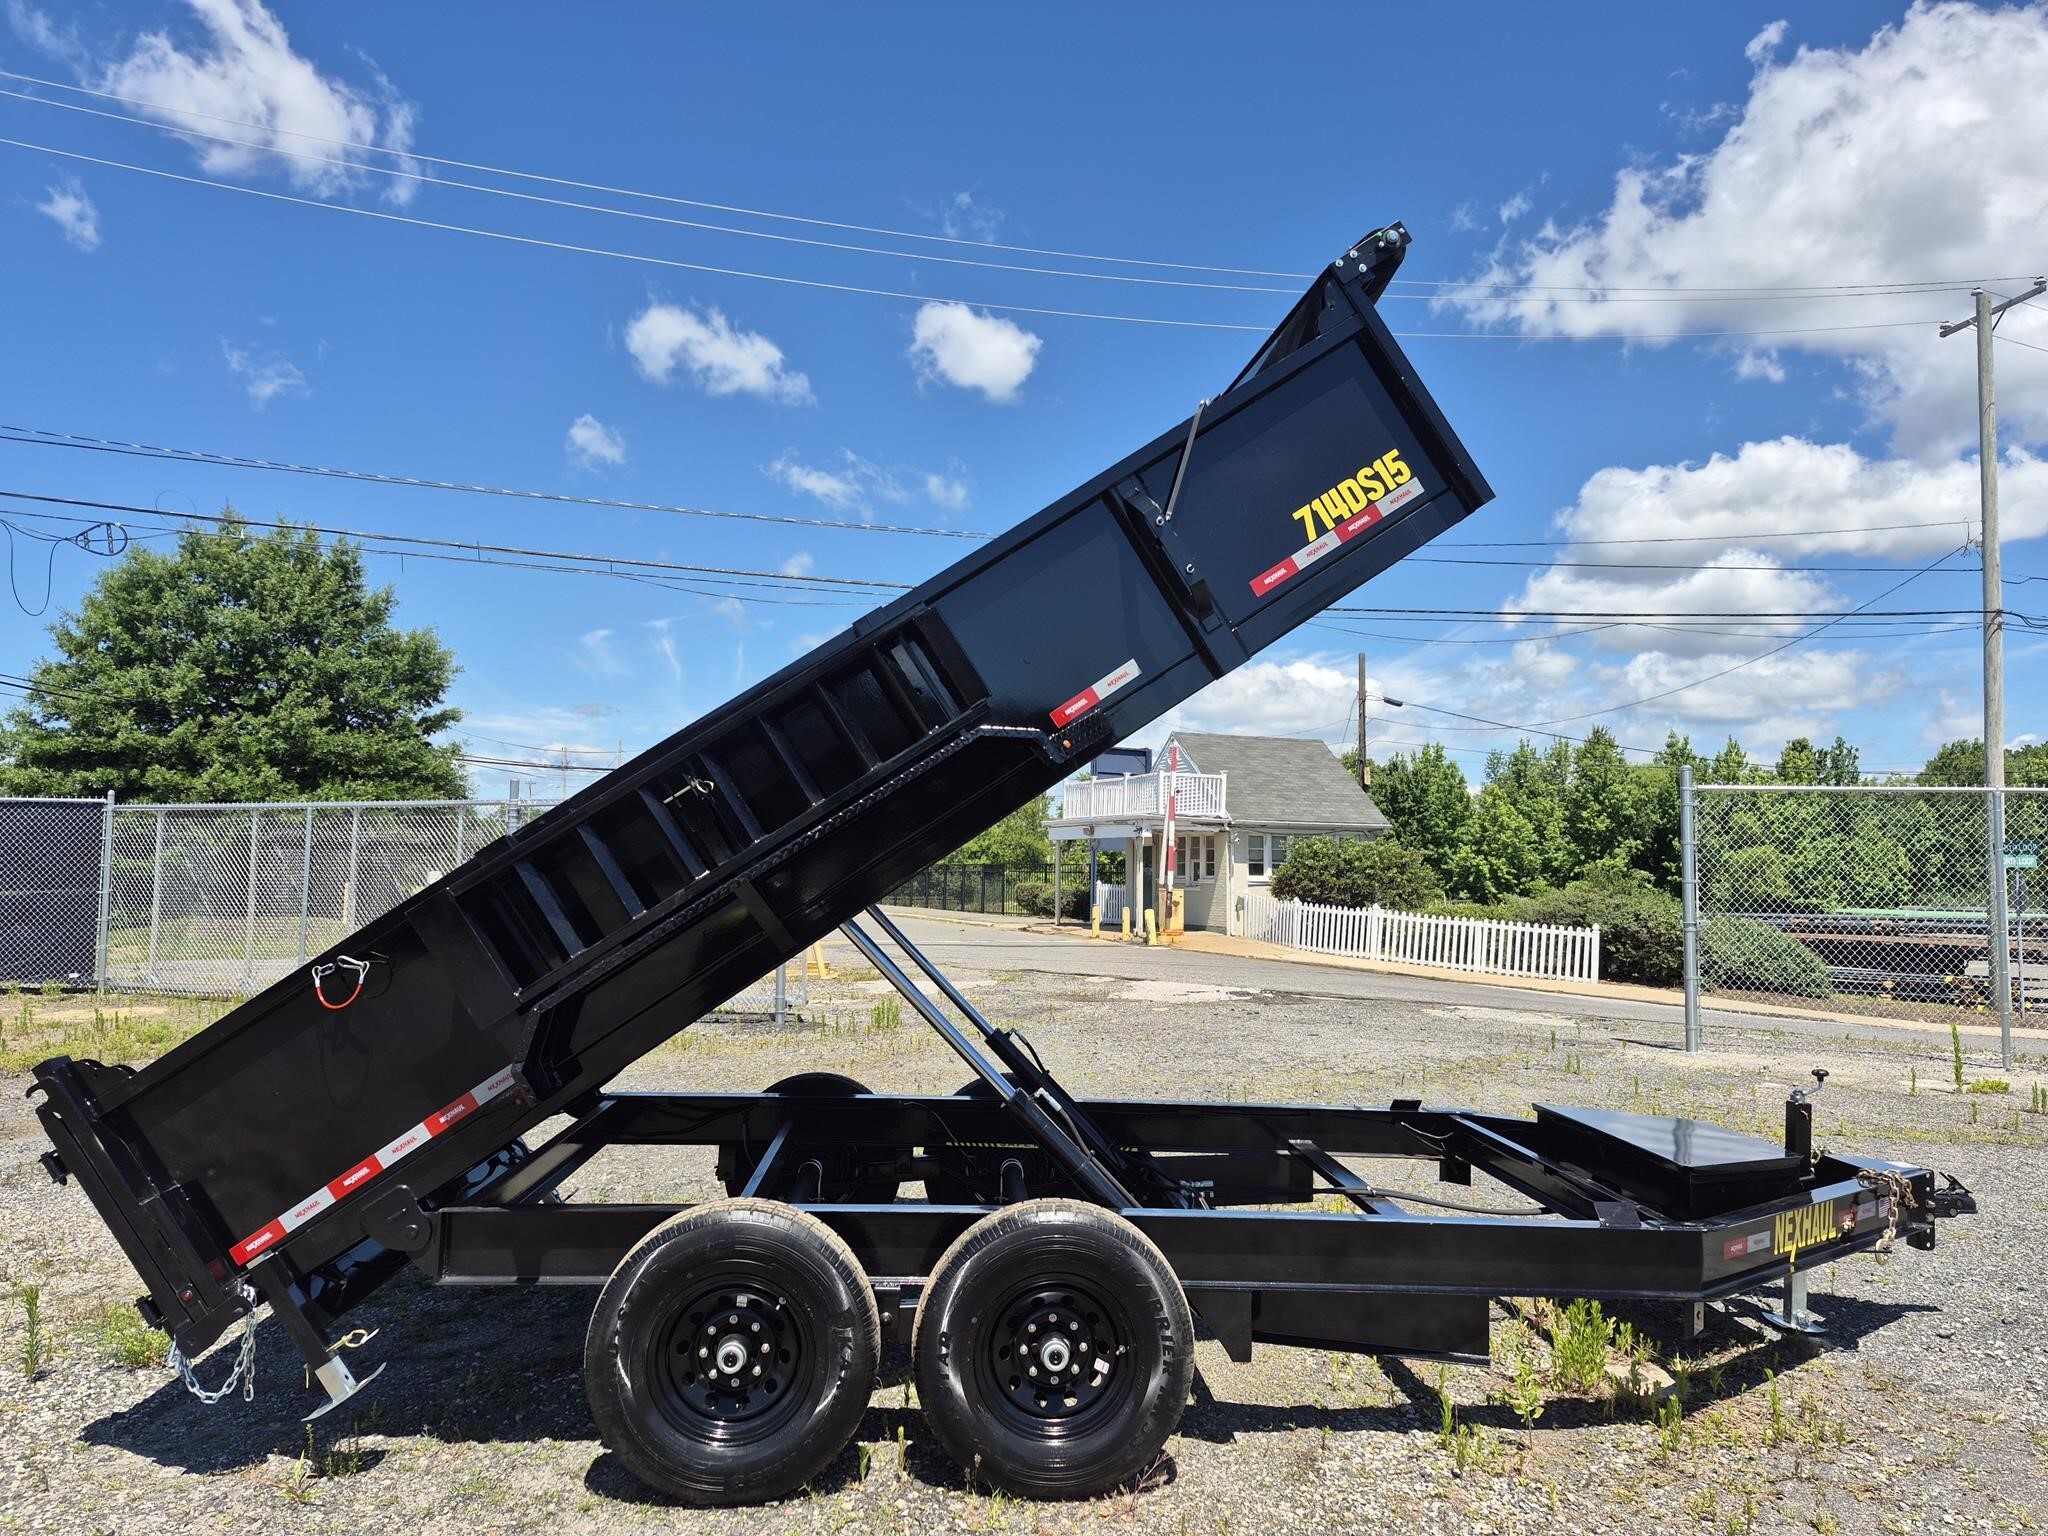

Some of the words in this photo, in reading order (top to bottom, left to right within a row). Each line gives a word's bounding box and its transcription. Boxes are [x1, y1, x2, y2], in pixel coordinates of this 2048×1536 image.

[1292, 448, 1412, 543] 714DS15
[245, 1232, 273, 1253] NEXHAUL
[294, 1200, 321, 1219] NEXHAUL
[343, 1166, 370, 1186] NEXHAUL
[391, 1136, 418, 1155] NEXHAUL
[439, 1104, 465, 1124] NEXHAUL
[1774, 1200, 1837, 1263] NEXHAUL
